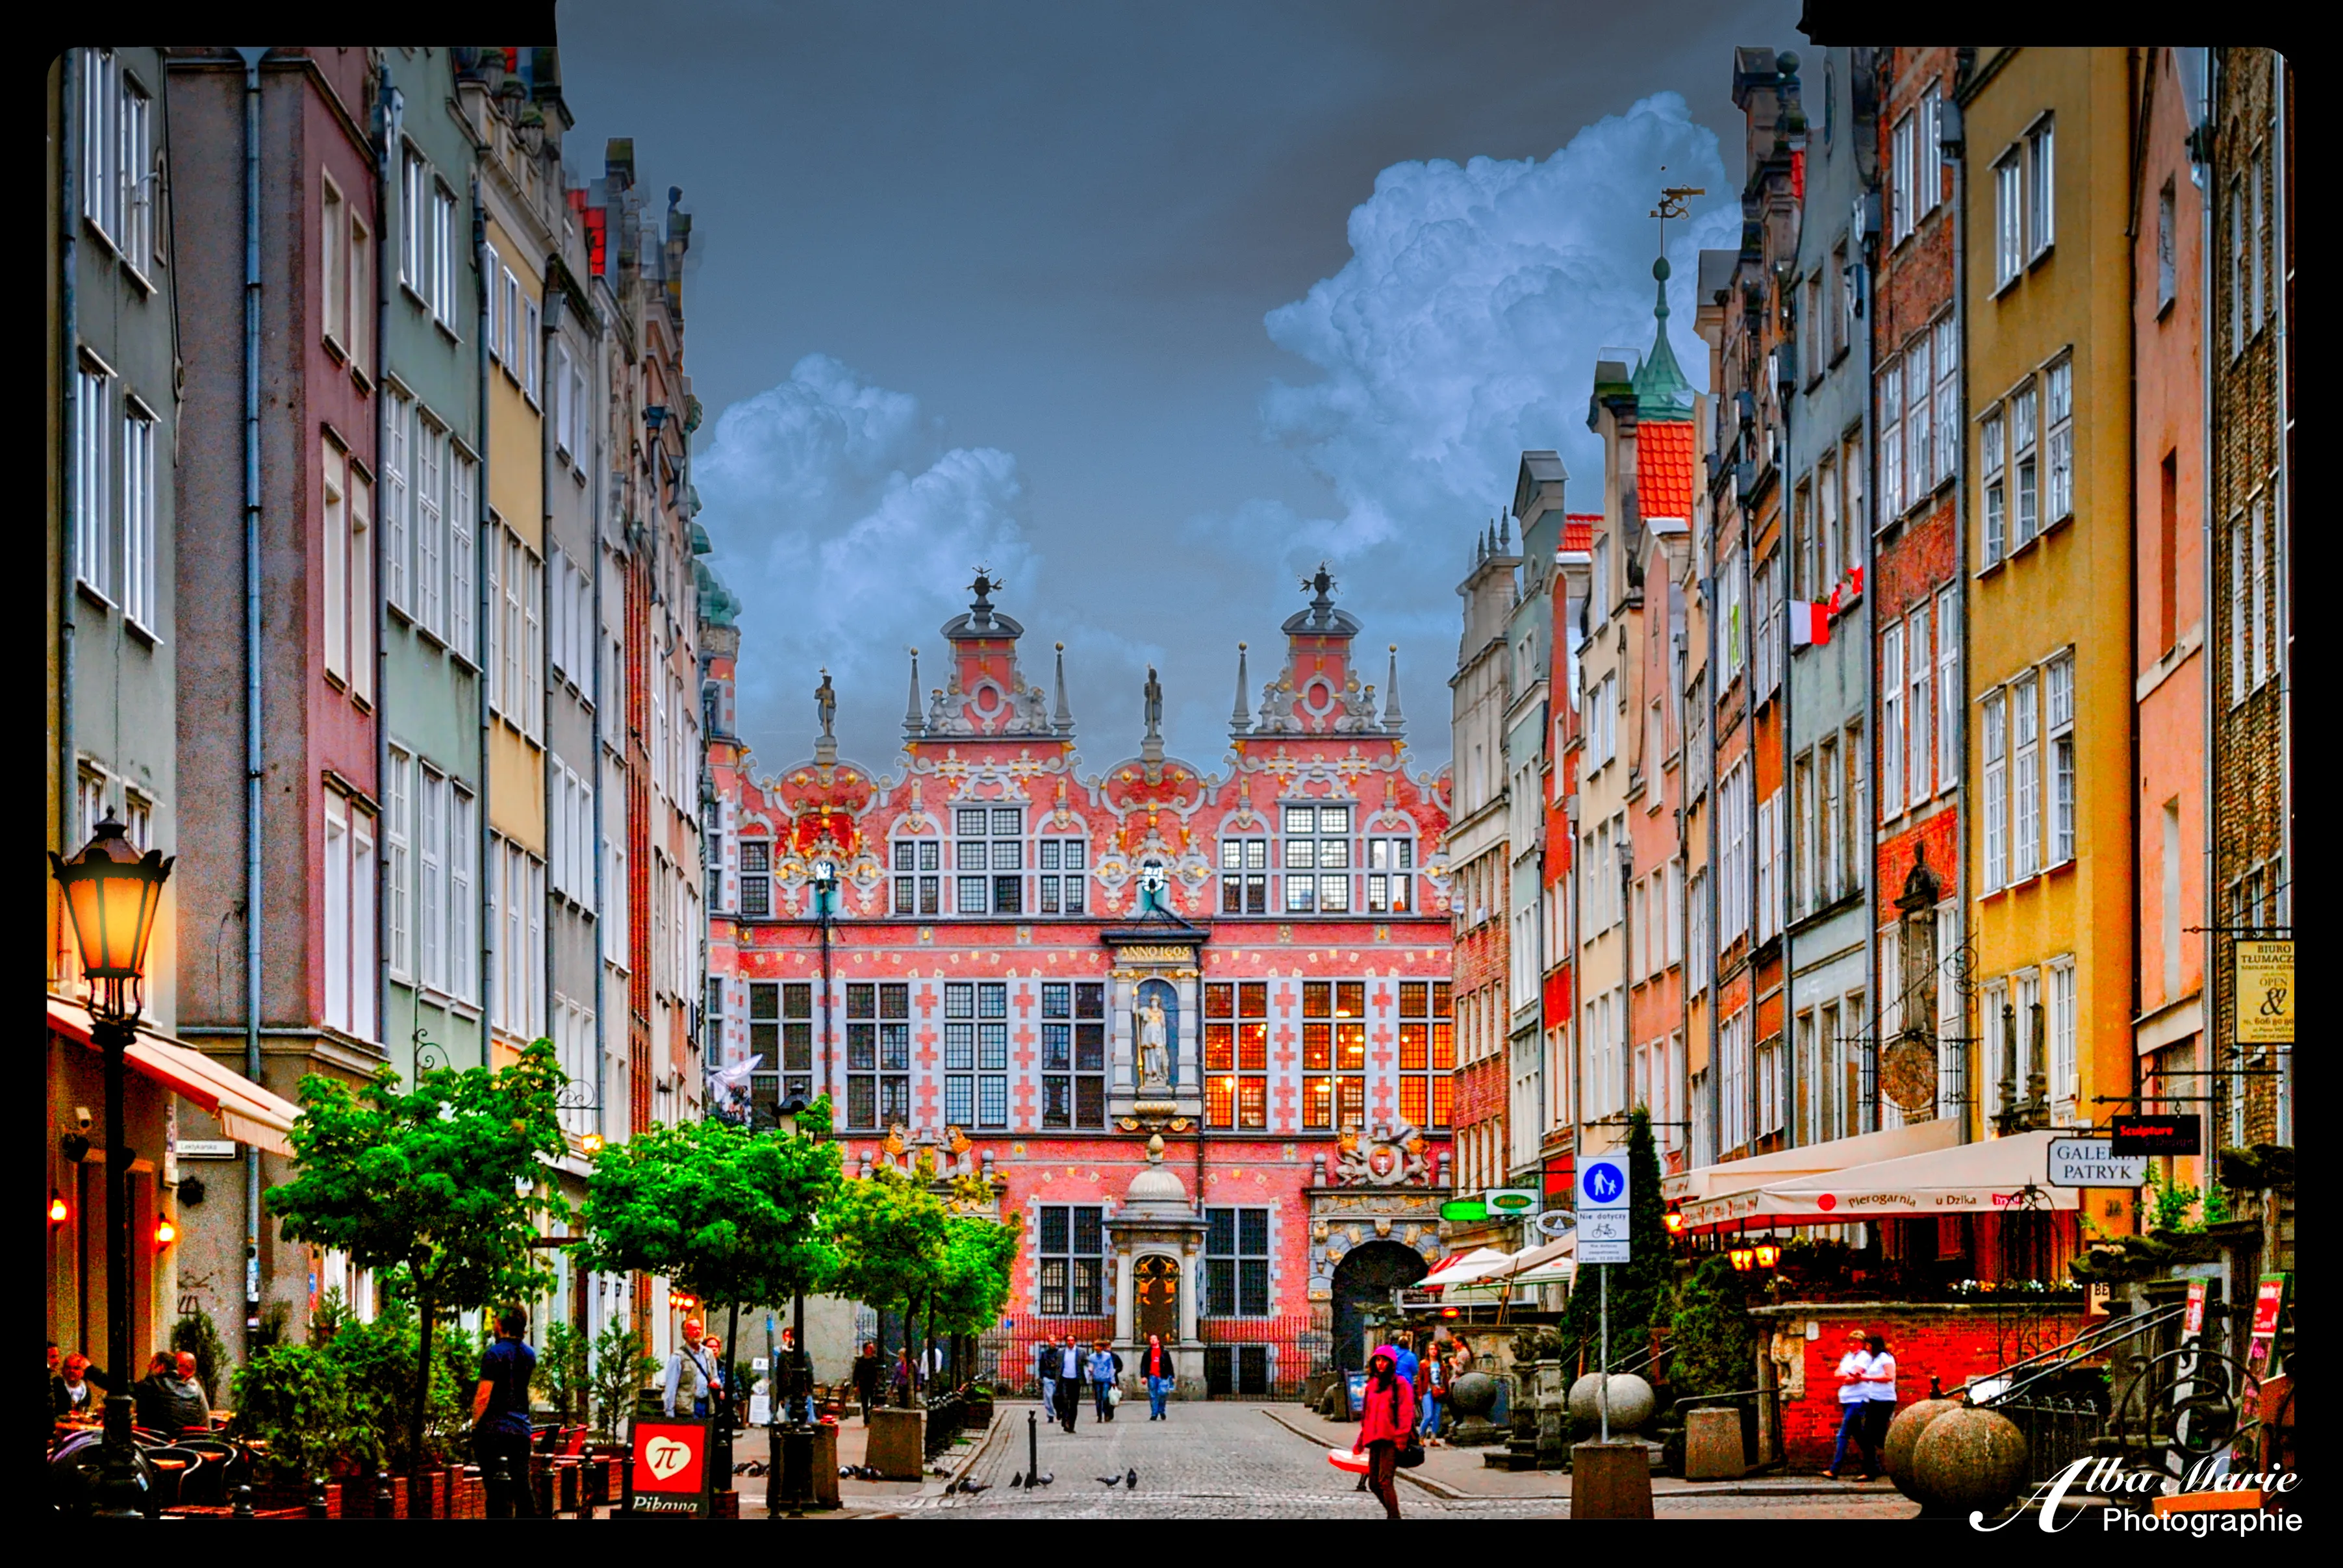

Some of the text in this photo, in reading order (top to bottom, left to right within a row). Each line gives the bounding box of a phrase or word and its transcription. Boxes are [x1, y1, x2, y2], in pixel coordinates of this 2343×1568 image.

[1121, 946, 1189, 957] ANNO 1605
[2257, 944, 2291, 954] BIURO
[2240, 955, 2294, 963] TŁUMACZ
[2260, 977, 2287, 987] OPEN
[2120, 1125, 2173, 1138] Sculpture
[2064, 1165, 2133, 1180] PATRYK
[1848, 1194, 1977, 1208] Pierogarnia u Dzika
[1597, 1213, 1627, 1221] dotyczy
